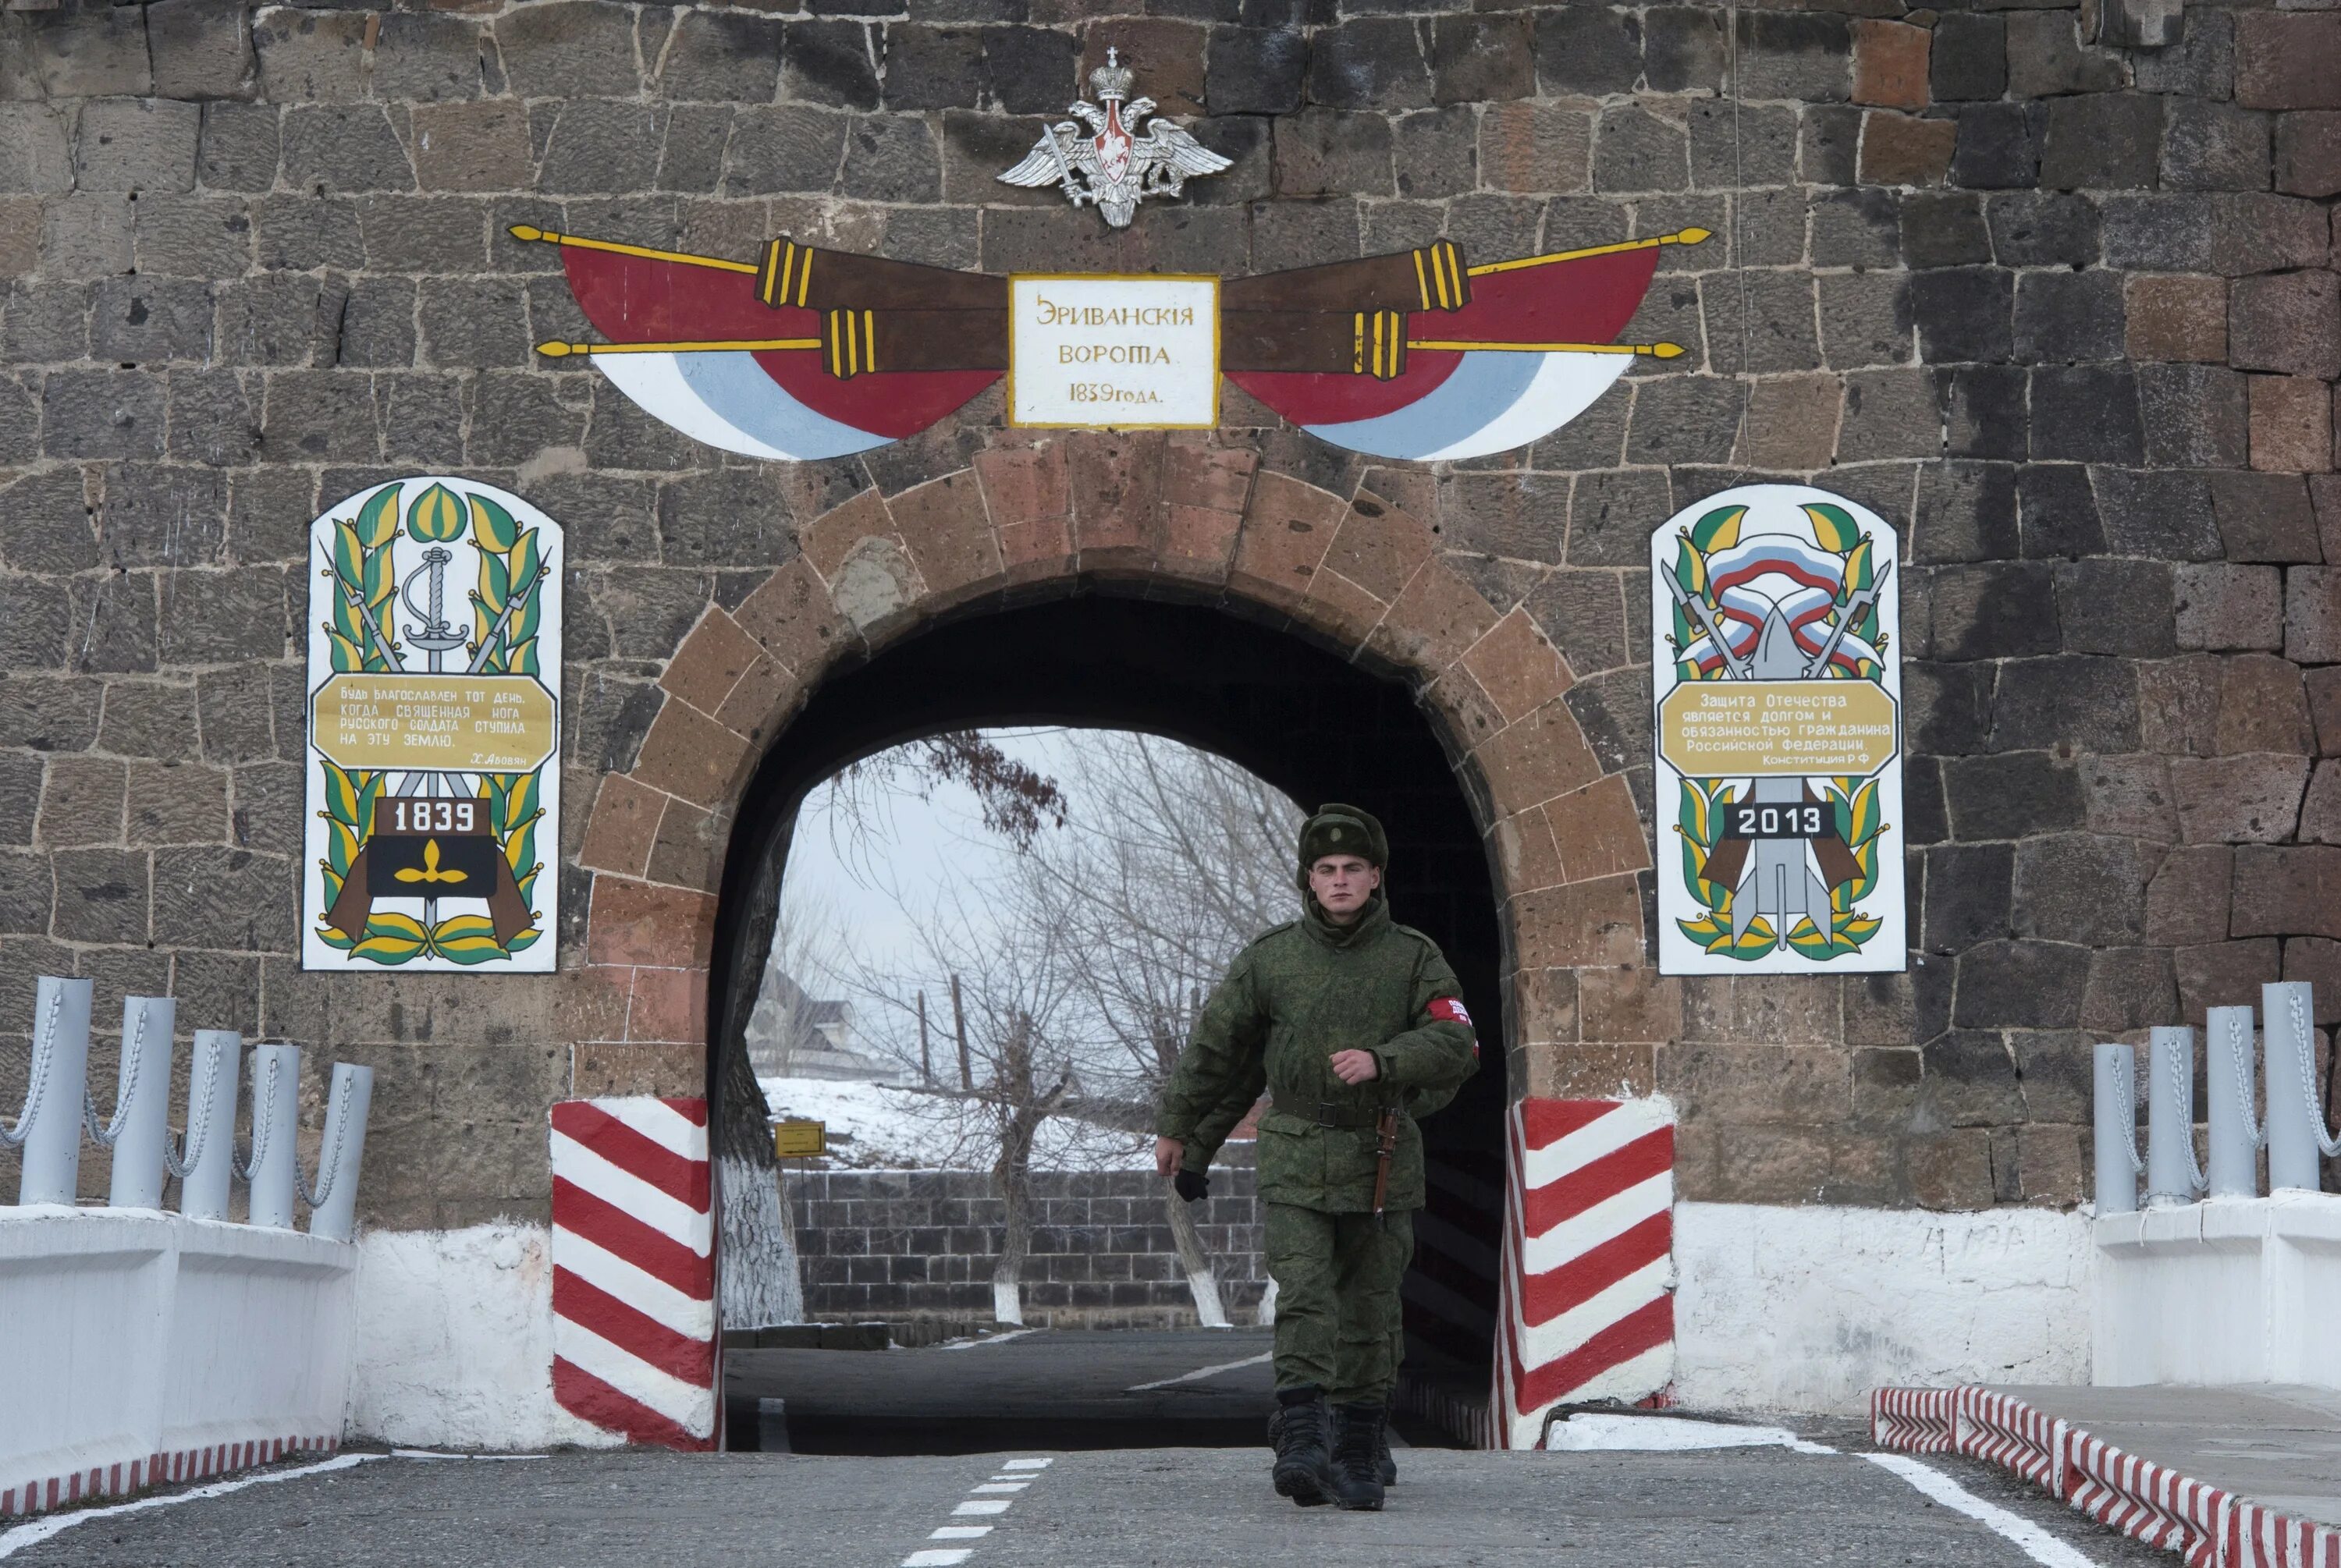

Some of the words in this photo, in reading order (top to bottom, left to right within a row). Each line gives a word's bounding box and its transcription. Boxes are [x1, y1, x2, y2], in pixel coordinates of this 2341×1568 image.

[1059, 345, 1170, 364] ВОРОТА
[465, 691, 485, 703] ТОТ
[1700, 694, 1756, 708] Защита
[1766, 694, 1848, 708] Отечества
[340, 704, 379, 718] КОГДА
[396, 704, 471, 718] СВЯЩЕННАЯ
[492, 708, 520, 719] НОГА
[1682, 711, 1751, 723] является
[1760, 711, 1815, 724] долгом
[1821, 711, 1832, 722] и
[340, 718, 399, 731] РУССКОГО
[410, 718, 459, 733] СОЛДАТА
[474, 720, 525, 734] СТУПИЛА
[1682, 725, 1791, 738] обязанностью
[340, 733, 357, 745] НА
[368, 733, 390, 746] ЭТУ
[403, 733, 456, 747] ЗЕМЛЮ.
[1686, 738, 1774, 752] Российской
[1762, 754, 1845, 766] Конституция
[396, 802, 474, 831] 1839
[1739, 807, 1821, 834] 2013
